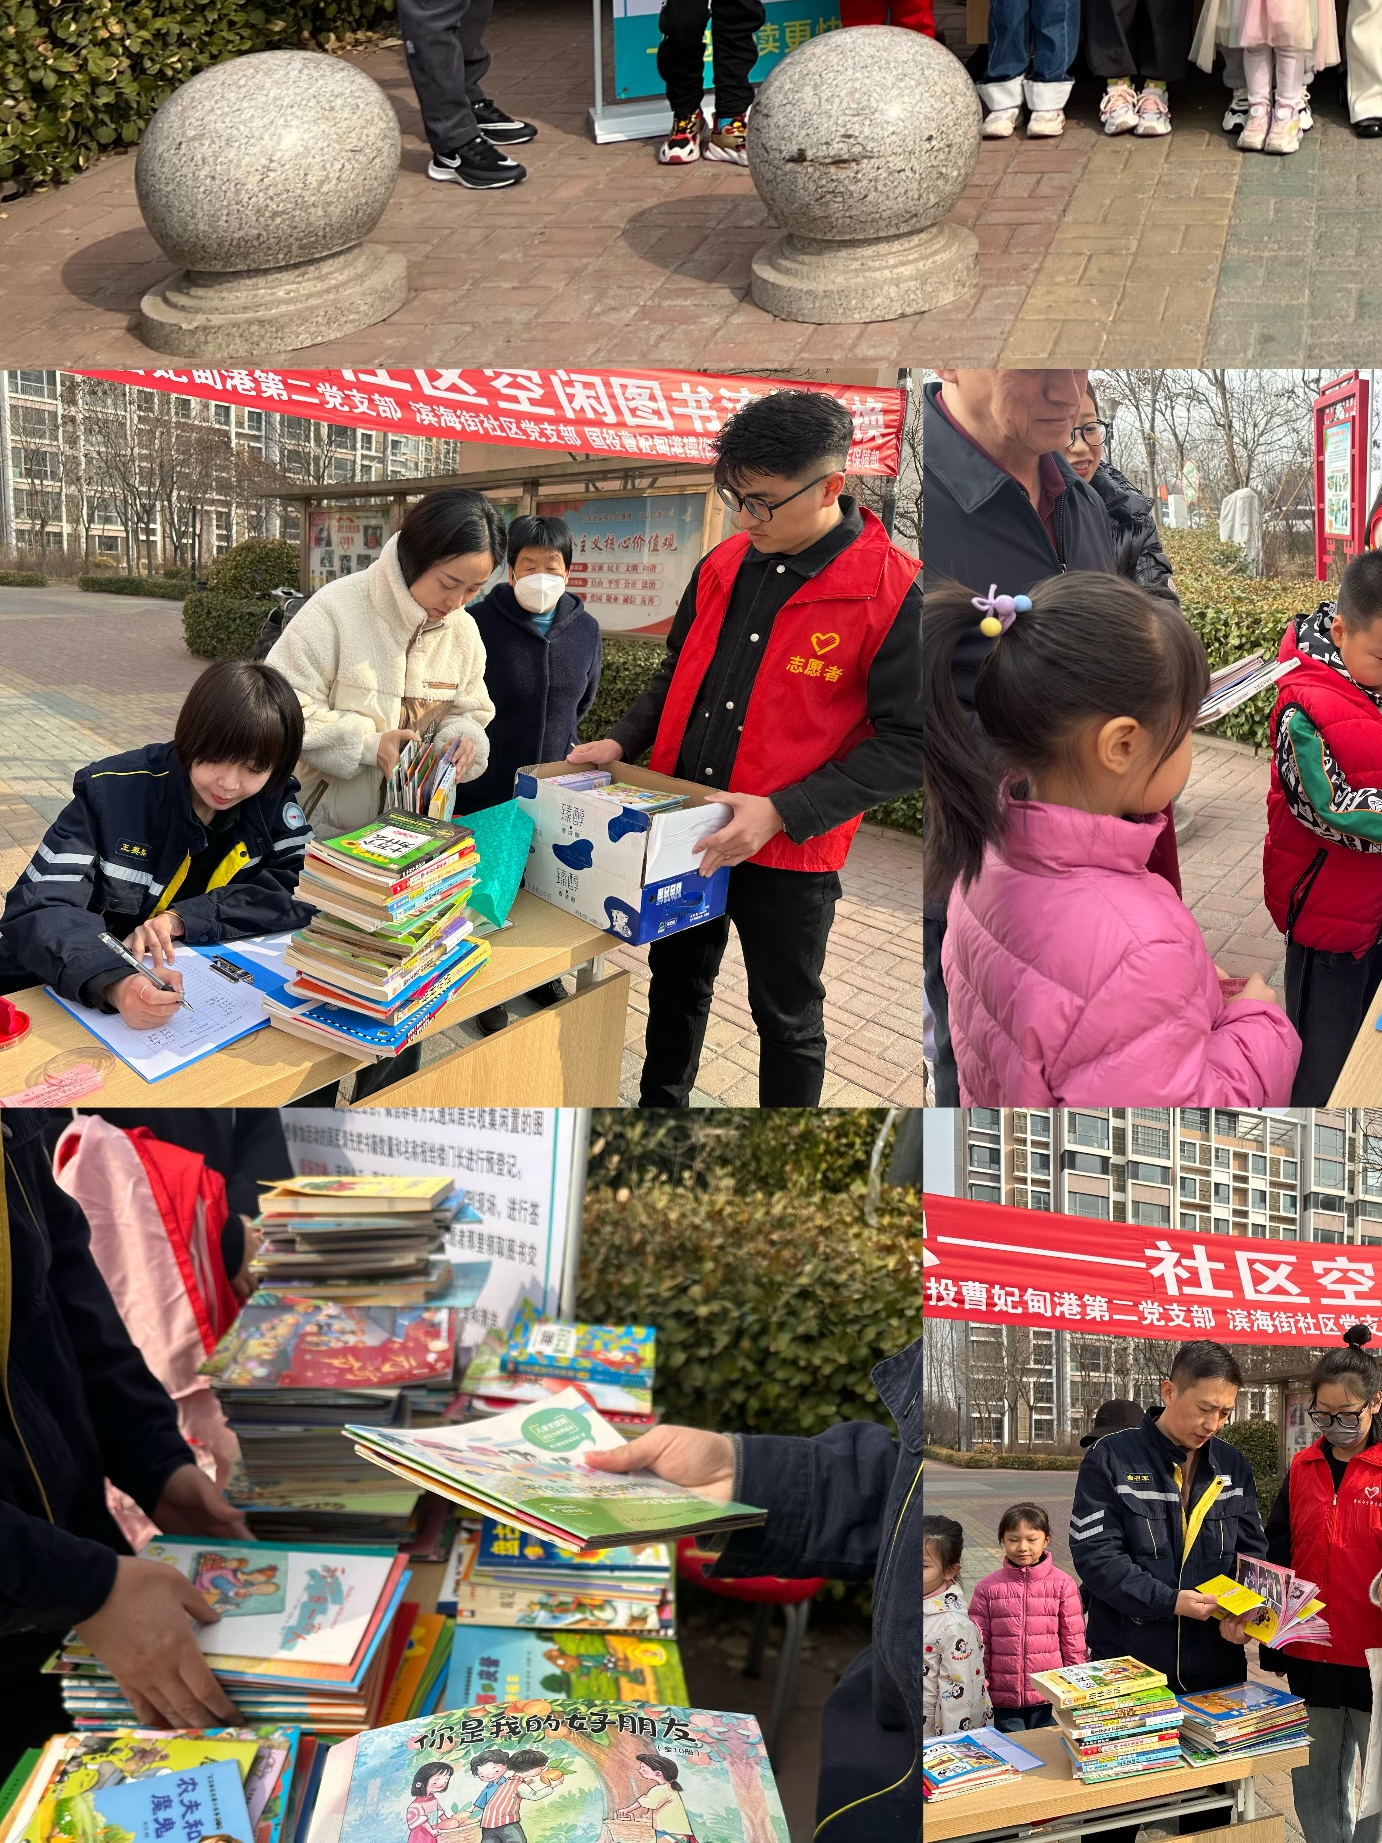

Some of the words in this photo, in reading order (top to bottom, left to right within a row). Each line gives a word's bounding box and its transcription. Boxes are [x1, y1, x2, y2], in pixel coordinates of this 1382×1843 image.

[409, 400, 581, 447] 滨海街社区党支部
[786, 655, 843, 682] 志愿者
[412, 1711, 700, 1751] 你是我的好朋友
[151, 1794, 177, 1839] 魔鬼
